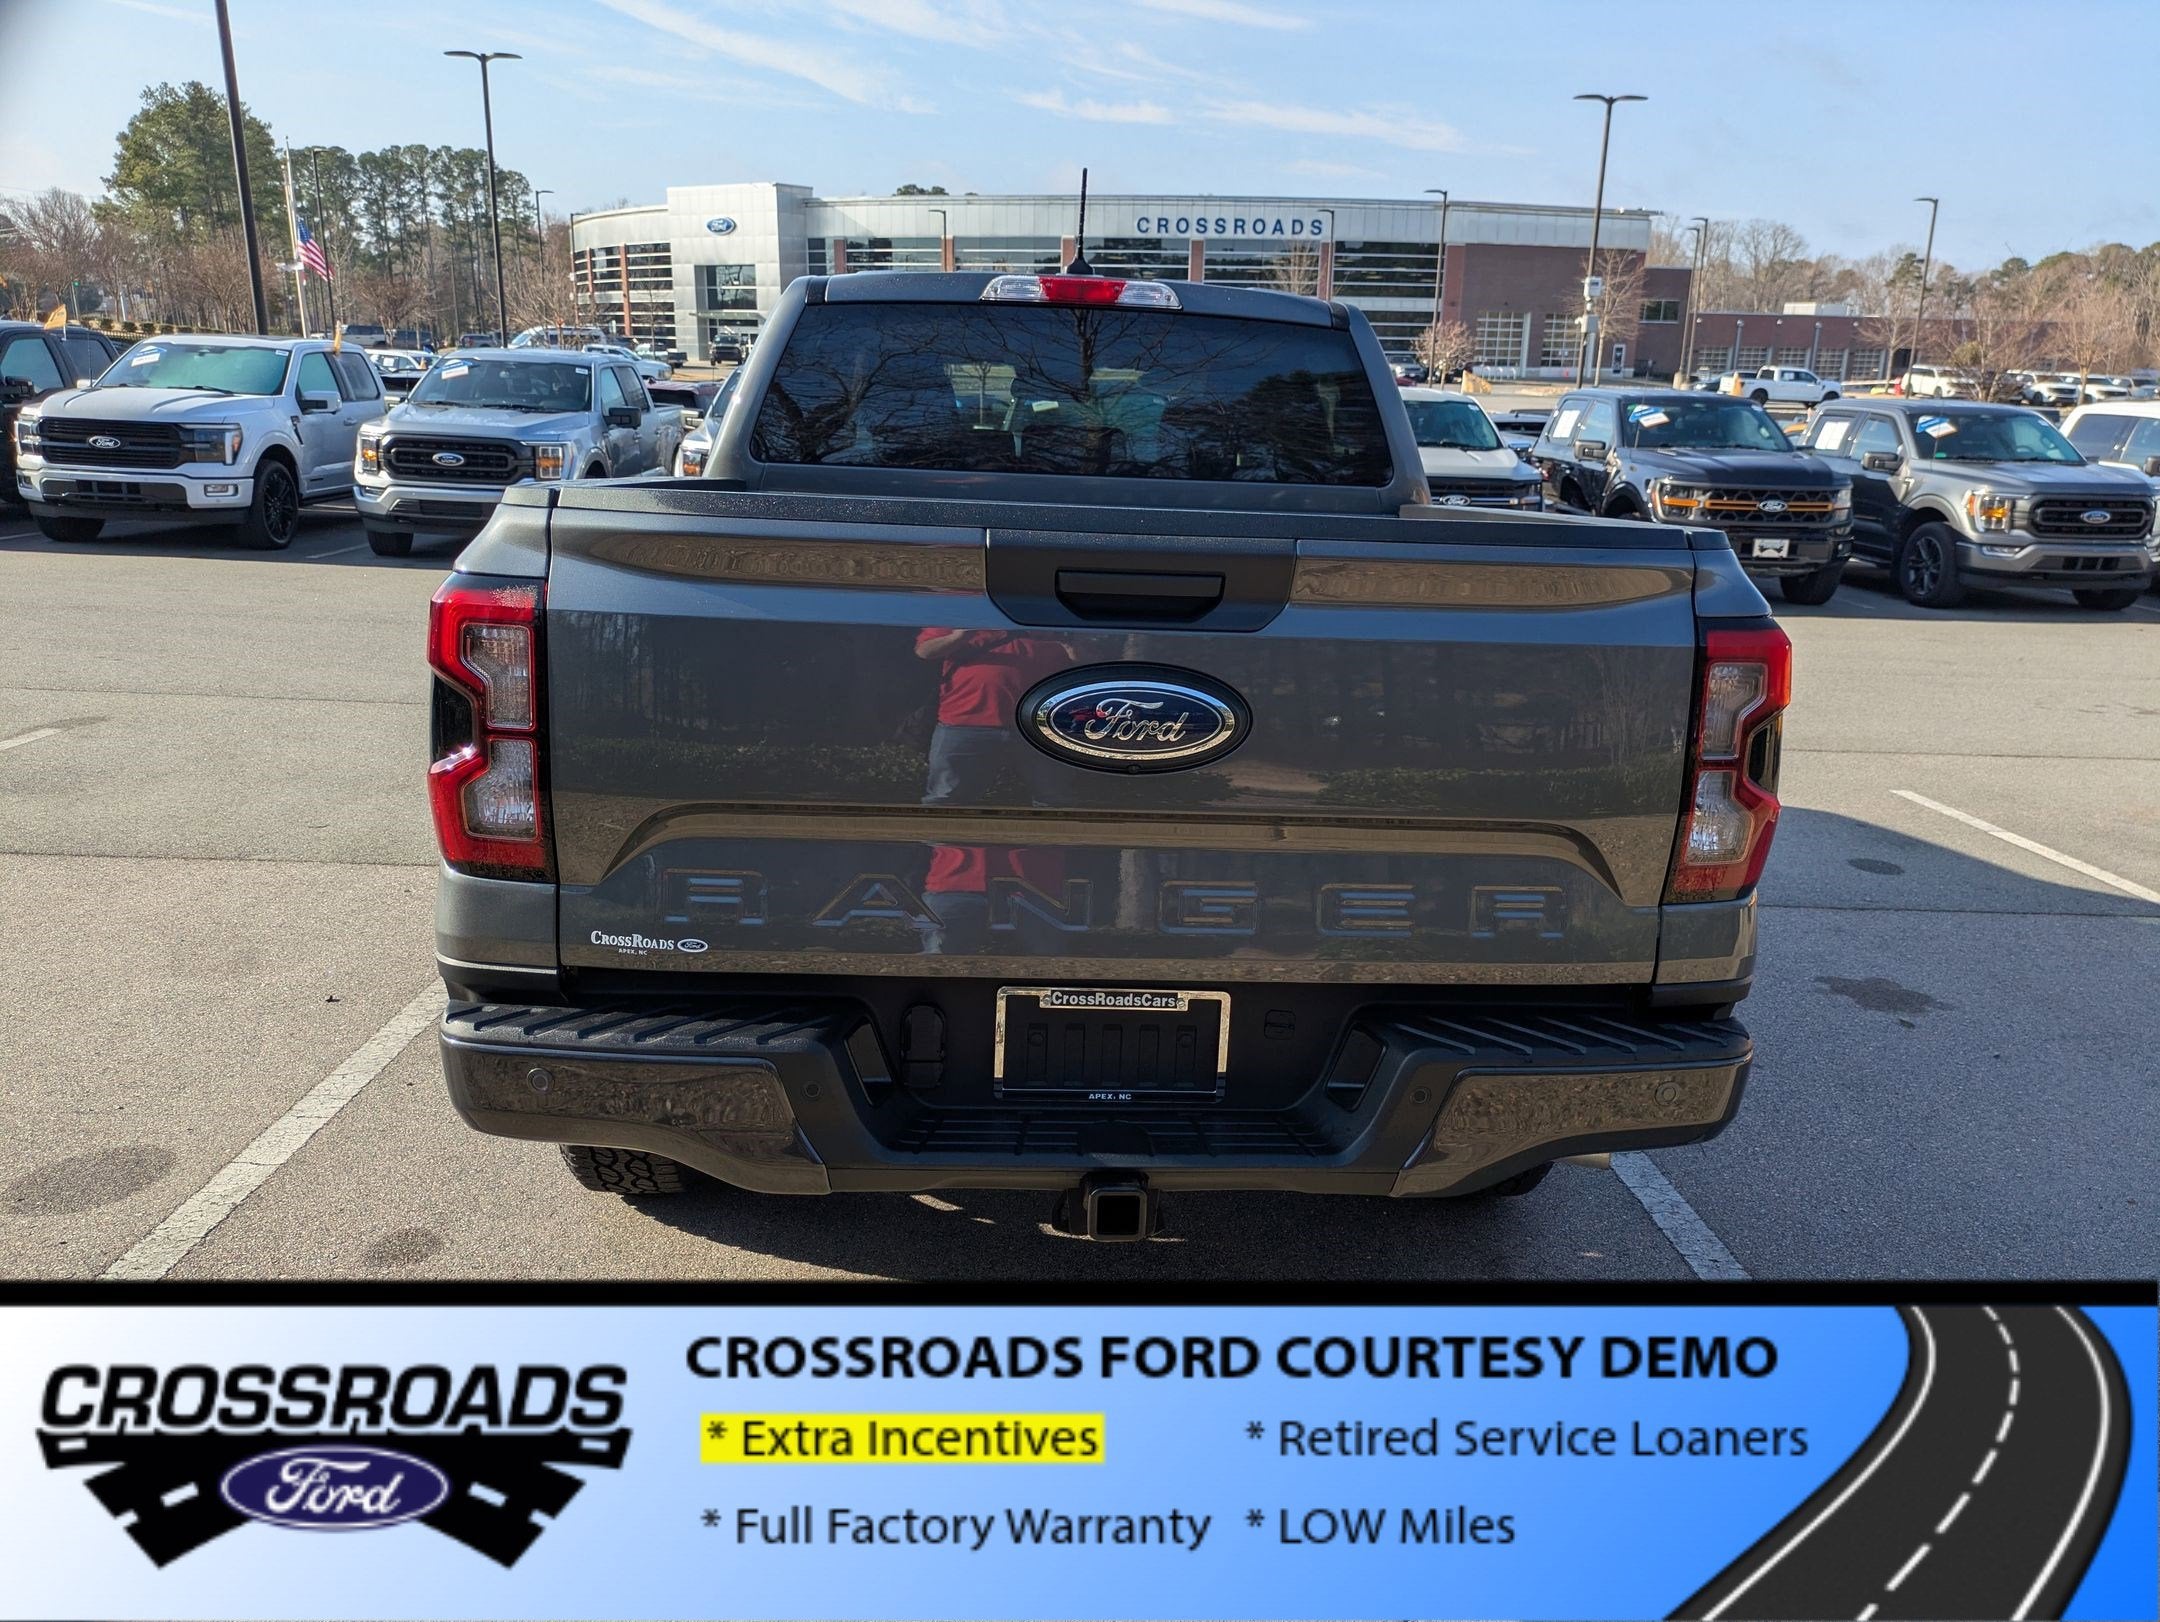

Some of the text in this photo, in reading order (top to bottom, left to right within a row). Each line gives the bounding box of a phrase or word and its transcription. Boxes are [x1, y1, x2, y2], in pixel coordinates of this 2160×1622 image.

[1136, 217, 1323, 236] CROSSROADS
[1083, 698, 1190, 742] Ford
[660, 867, 1568, 939] RANGER
[1052, 991, 1176, 1008] CrossRoadsCars
[1118, 1093, 1132, 1101] NC
